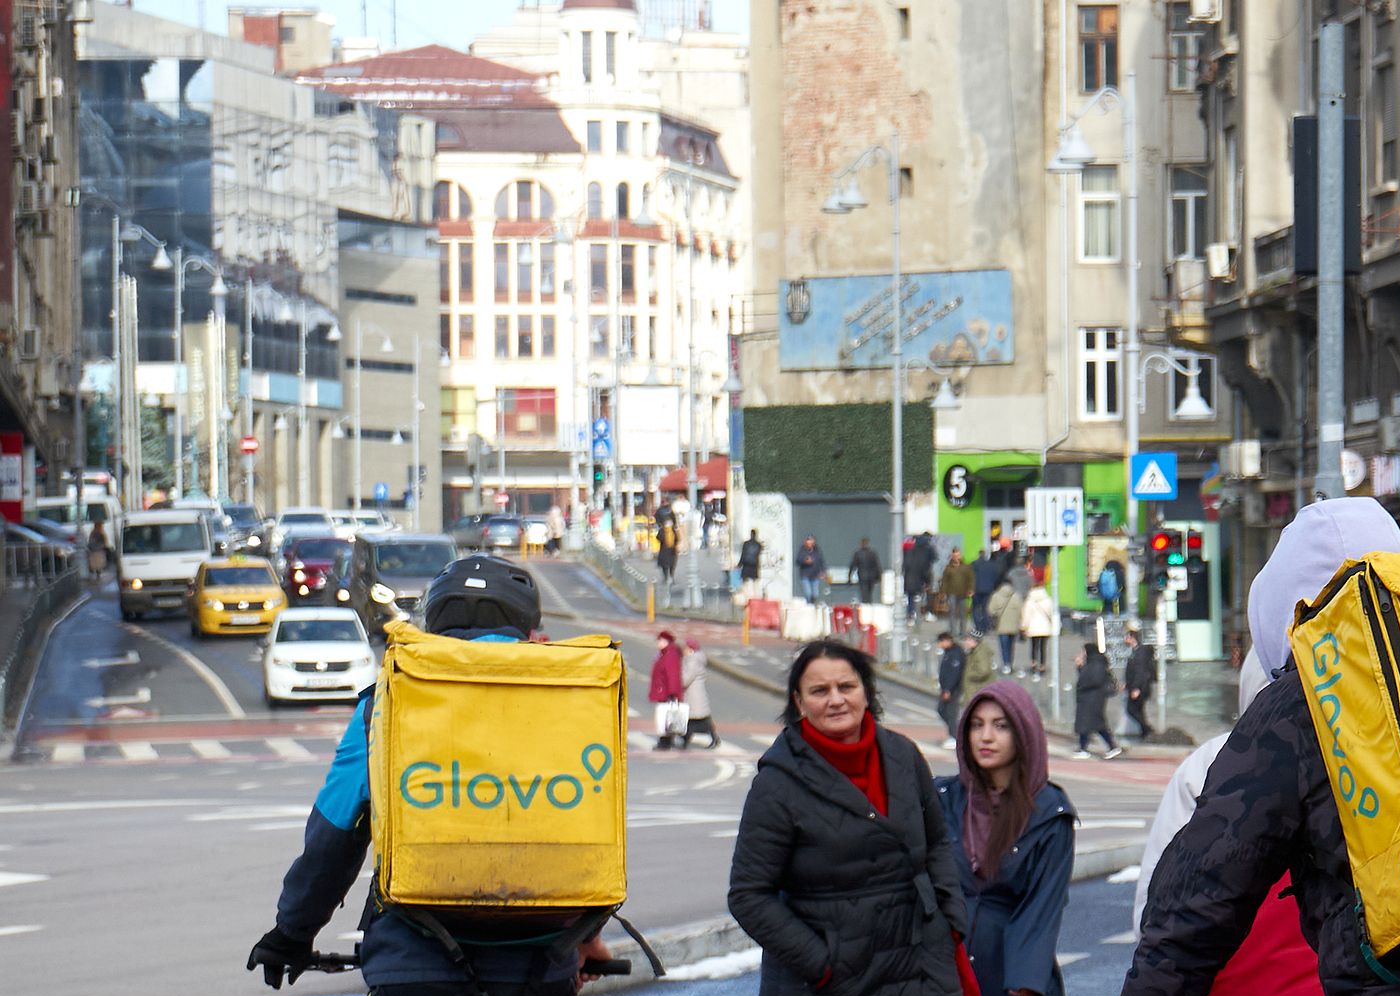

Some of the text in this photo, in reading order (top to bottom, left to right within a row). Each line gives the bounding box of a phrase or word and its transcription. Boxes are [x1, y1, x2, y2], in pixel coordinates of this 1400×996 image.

[949, 466, 967, 498] 5
[1312, 632, 1357, 803] Glovo
[399, 760, 583, 810] Glovo
